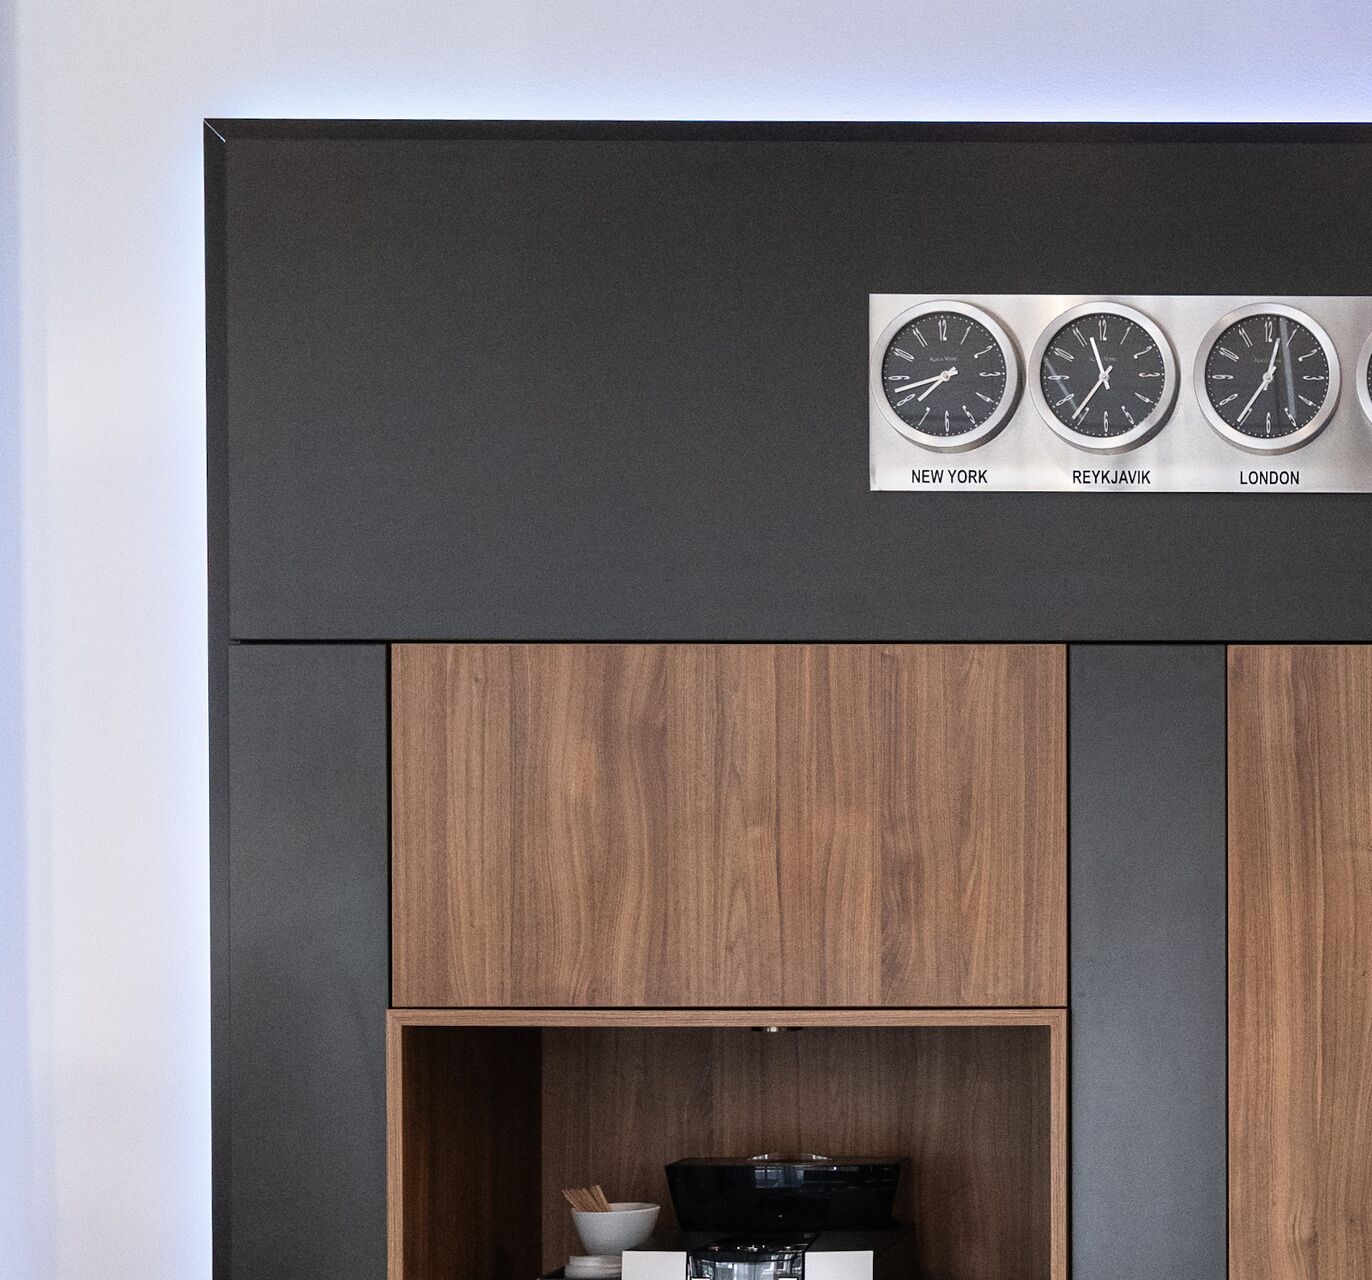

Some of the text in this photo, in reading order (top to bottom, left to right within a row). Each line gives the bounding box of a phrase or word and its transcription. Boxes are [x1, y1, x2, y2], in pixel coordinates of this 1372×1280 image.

[938, 320, 947, 340] 12
[1098, 320, 1107, 340] 12
[1265, 321, 1273, 342] 12
[894, 348, 914, 362] 10
[1054, 348, 1074, 361] 10
[1219, 347, 1239, 361] 10
[912, 470, 988, 484] NEW YORK
[1072, 470, 1150, 484] REYKJAVIK
[1240, 471, 1300, 485] LONDON
